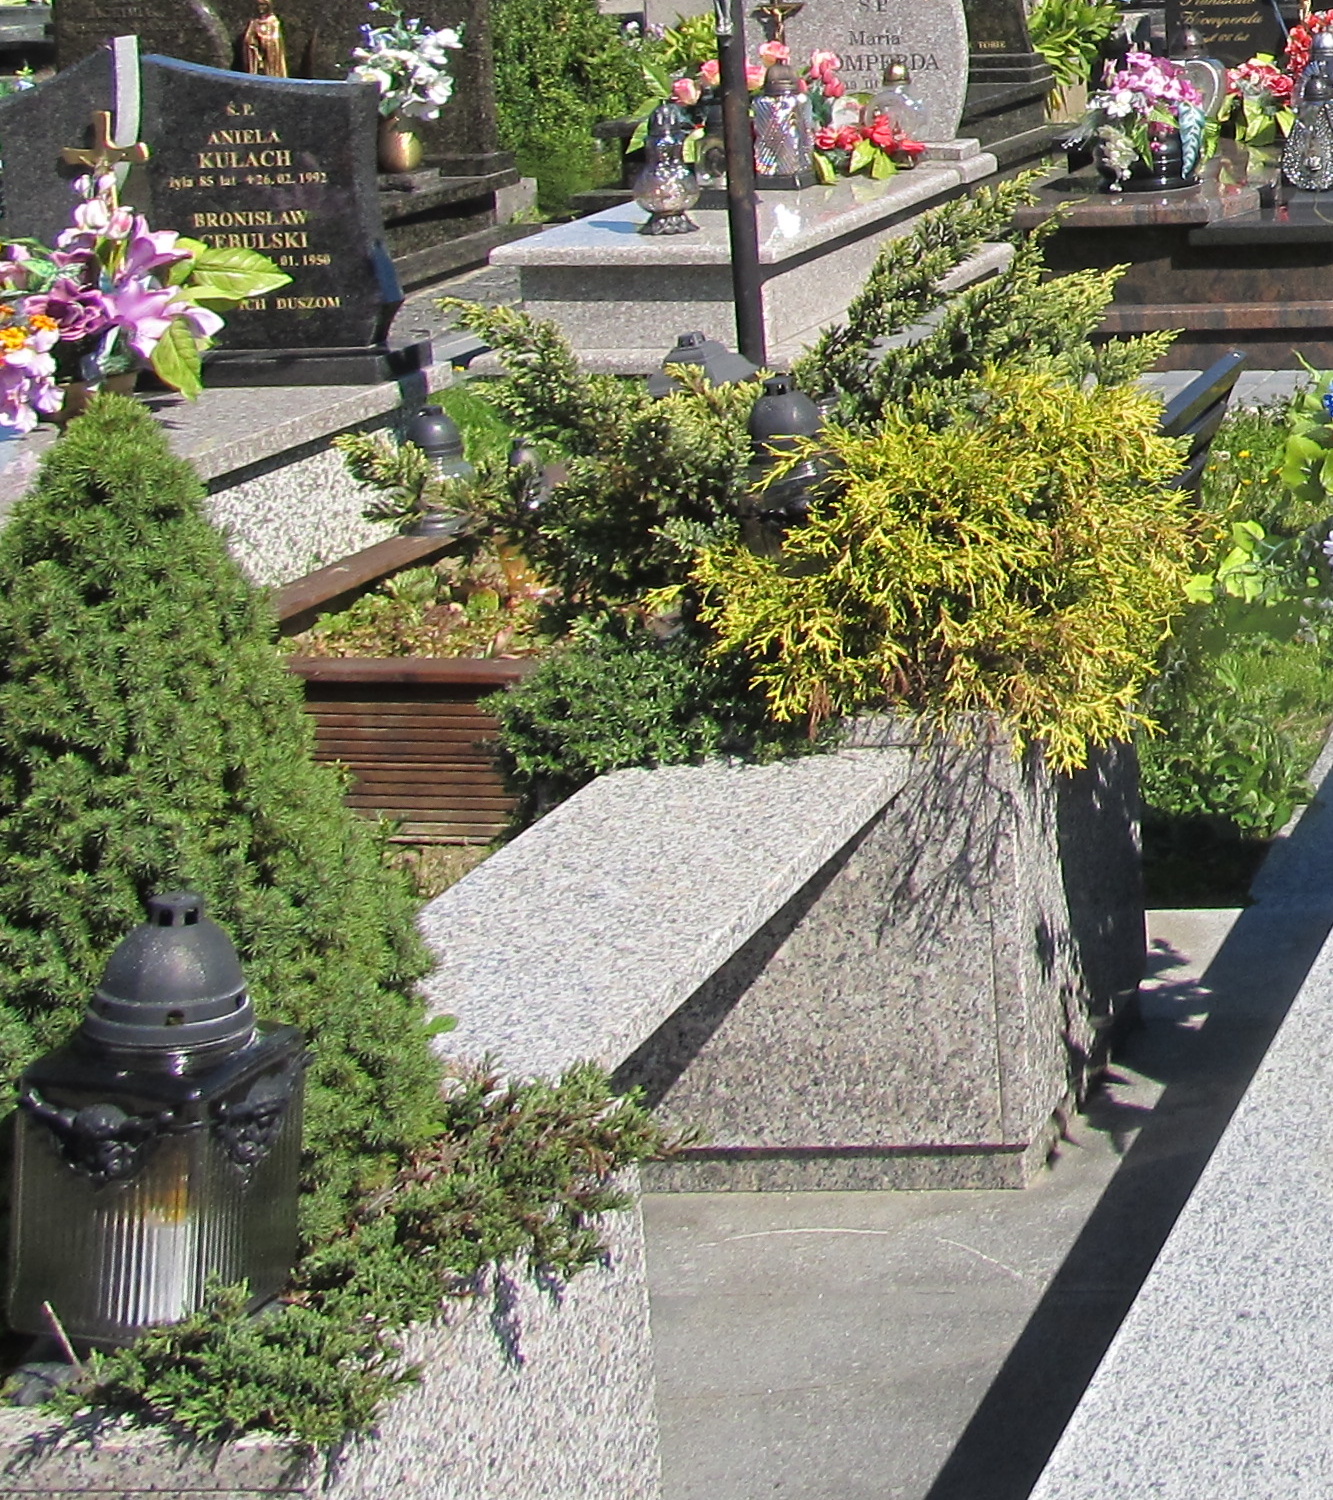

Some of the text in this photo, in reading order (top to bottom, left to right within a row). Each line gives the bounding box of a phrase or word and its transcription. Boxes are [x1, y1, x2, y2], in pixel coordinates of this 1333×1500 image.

[848, 29, 901, 46] Maria
[208, 129, 281, 145] ANIELA
[276, 297, 340, 309] DUSZOM
